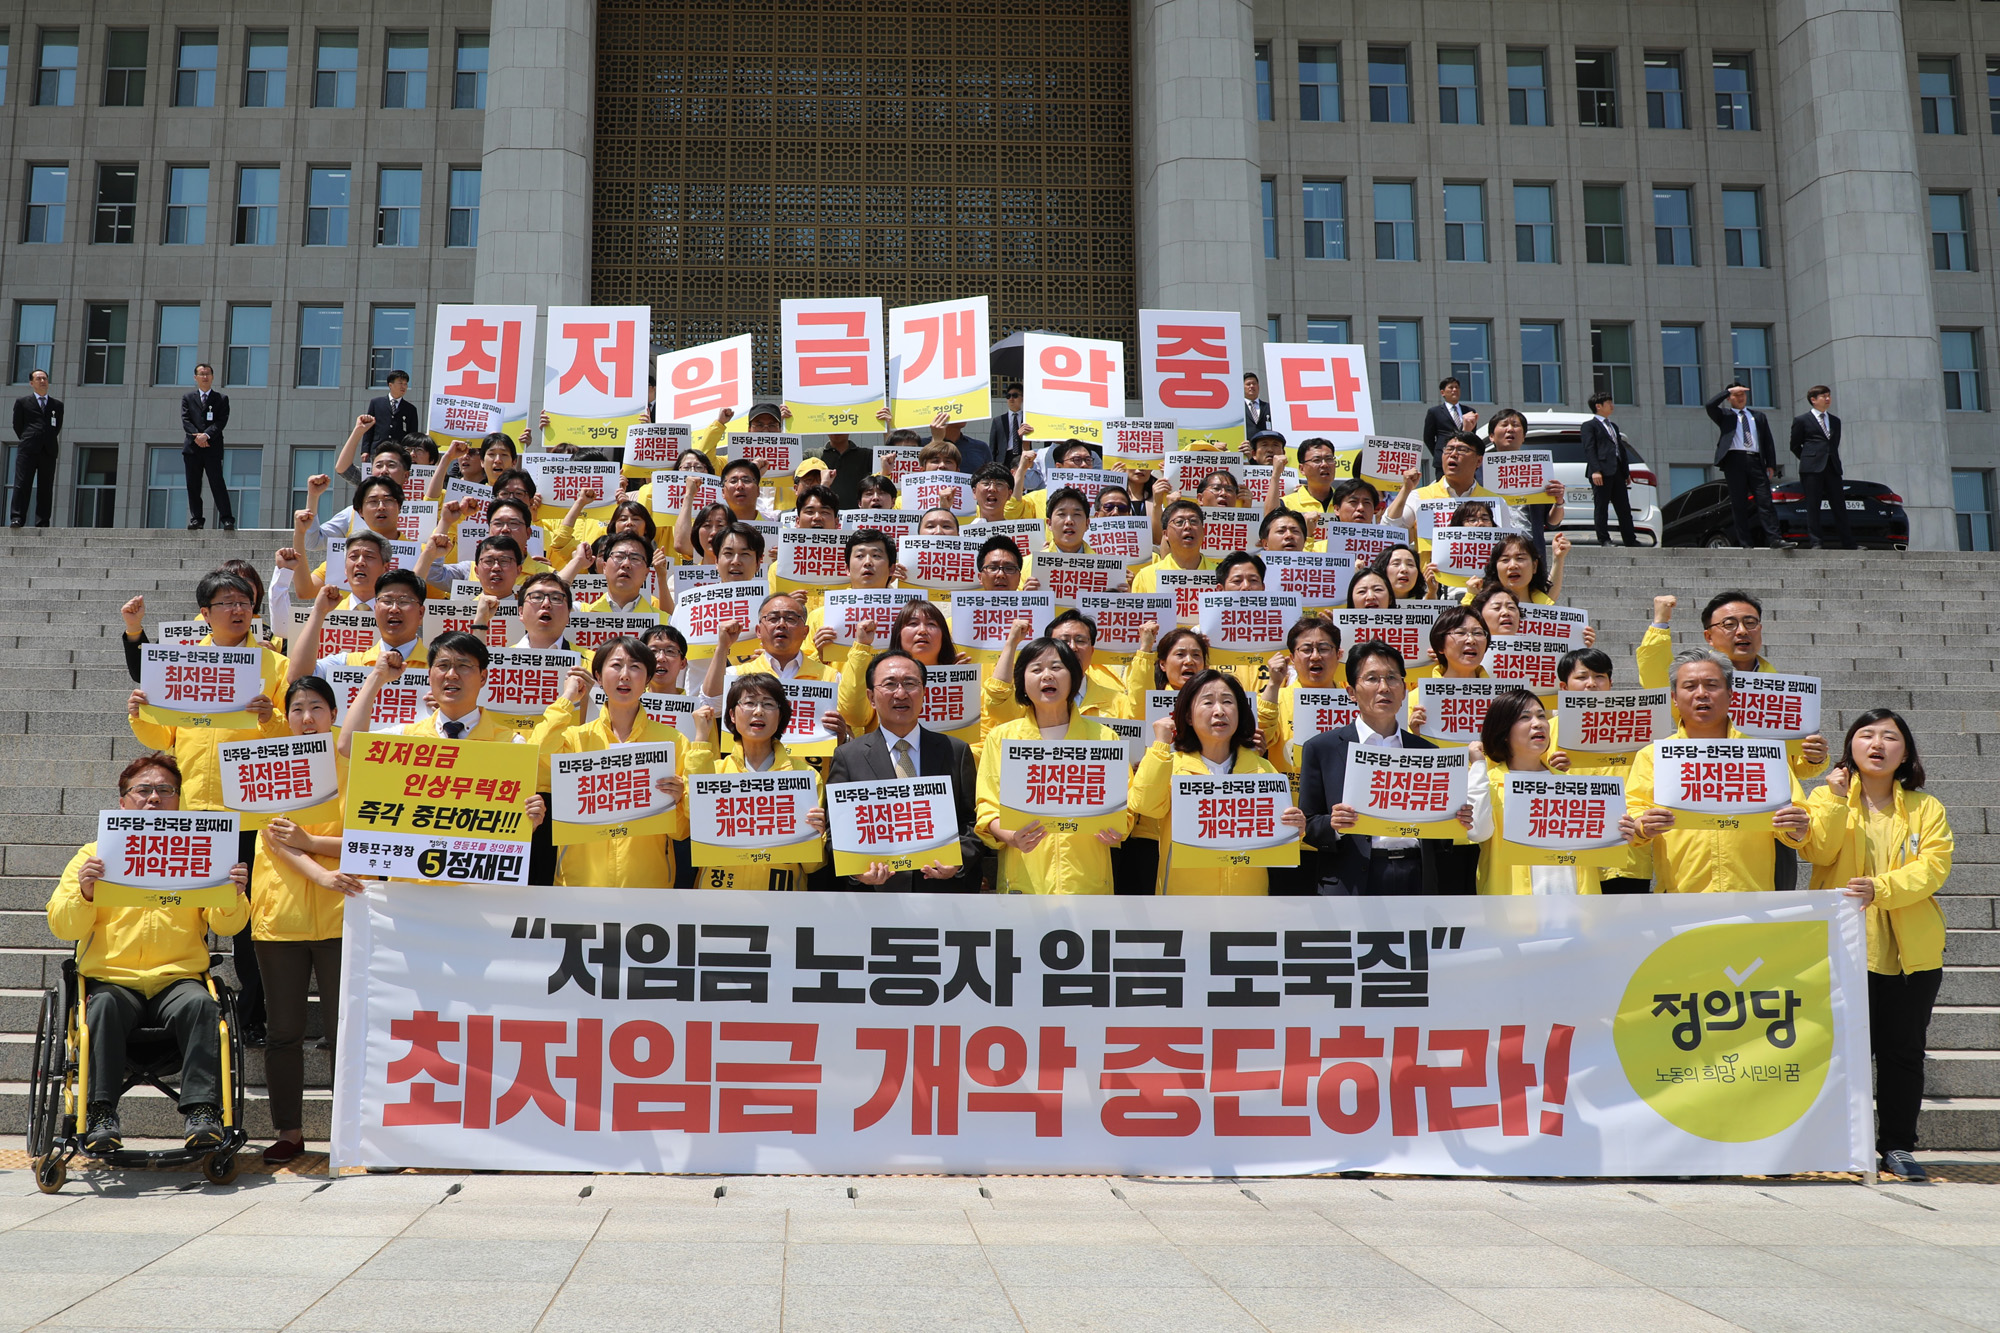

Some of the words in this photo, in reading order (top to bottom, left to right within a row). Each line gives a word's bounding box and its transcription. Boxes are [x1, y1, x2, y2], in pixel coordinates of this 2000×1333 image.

[796, 312, 870, 386] 금
[904, 310, 976, 383] 개
[444, 319, 521, 403] 최
[560, 321, 635, 397] 저
[1156, 325, 1230, 409] 중
[672, 349, 738, 420] 임
[1040, 346, 1115, 408] 악
[1281, 358, 1360, 432] 단
[446, 408, 488, 420] 최저임금
[829, 414, 858, 426] 정의당
[444, 420, 487, 432] 개악규탄
[588, 428, 618, 439] 정의당
[1070, 426, 1098, 437] 정의당
[635, 438, 677, 449] 최저임금
[1118, 431, 1163, 442] 최저임금
[1369, 440, 1405, 449] 민주당-한국당
[634, 450, 678, 461] 개악규탄
[743, 447, 789, 458] 최저임금
[1118, 442, 1164, 453] 개악규탄
[1378, 450, 1416, 464] 최저임금
[1499, 464, 1542, 477] 최저임금
[554, 476, 603, 488] 최저임금
[1499, 477, 1543, 488] 개악규탄
[783, 534, 837, 544] 민주당-한국당
[964, 525, 1015, 538] 민주당-한국당
[905, 540, 960, 550] 민주당-한국당
[918, 552, 974, 567] 최저임금
[1038, 557, 1095, 568] 민주당-한국당
[1266, 556, 1322, 566] 민주당-한국당
[917, 565, 975, 582] 개악규탄
[1050, 569, 1107, 587] 최저임금
[1282, 568, 1334, 582] 최저임금
[682, 588, 733, 606] 민주당-한국당
[957, 596, 1018, 606] 민주당-한국당
[1082, 598, 1144, 608] 민주당-한국당
[1205, 596, 1267, 607] 민주당-한국당
[691, 600, 749, 621] 최저임금
[1222, 610, 1282, 625] 최저임금
[1340, 614, 1403, 625] 민주당-한국당
[1222, 627, 1283, 641] 개악규탄
[148, 650, 219, 664] 민주당-한국당
[223, 653, 254, 664] 짬짜미
[1493, 654, 1556, 671] 최저임금
[166, 666, 234, 684] 최저임금
[487, 668, 559, 688] 최저임금
[165, 685, 235, 702] 개악규탄
[488, 686, 559, 705] 개악규탄
[1788, 681, 1816, 694] 짬짜미
[1565, 696, 1636, 708] 민주당-한국당
[1638, 694, 1666, 706] 짬짜미
[1731, 691, 1802, 713] 최저임금
[1582, 709, 1652, 728] 최저임금
[1730, 708, 1802, 730] 개악규탄
[1581, 727, 1653, 744] 개악규탄
[223, 744, 289, 762] 민주당-한국당
[292, 740, 327, 755] 짬짜미
[365, 741, 459, 769] 최저임금
[1009, 747, 1087, 760] 민주당-한국당
[1090, 748, 1123, 760] 짬짜미
[1355, 751, 1434, 768] 민주당-한국당
[1437, 754, 1464, 768] 짬짜미
[1662, 745, 1744, 758] 민주당-한국당
[1747, 746, 1781, 759] 짬짜미
[559, 754, 632, 773] 민주당-한국당
[635, 750, 667, 765] 짬짜미
[238, 759, 310, 783] 최저임금
[1027, 764, 1105, 784] 최저임금
[1681, 762, 1765, 782] 최저임금
[404, 774, 520, 803] 인상무력화
[578, 768, 650, 795] 최저임금
[697, 779, 775, 794] 민주당-한국당
[778, 778, 810, 791] 짬짜미
[1180, 781, 1255, 795] 민주당-한국당
[1258, 777, 1287, 791] 짬짜미
[1371, 770, 1450, 791] 최저임금
[1513, 781, 1588, 795] 민주당-한국당
[1591, 783, 1620, 795] 짬짜미
[240, 779, 312, 802] 개악규탄
[835, 785, 910, 803] 민주당-한국당
[913, 782, 946, 796] 짬짜미
[1026, 785, 1106, 805] 개악규탄
[1681, 783, 1768, 802] 개악규탄
[578, 788, 651, 814] 개악규탄
[716, 795, 795, 817] 최저임금
[1199, 798, 1274, 818] 최저임금
[1369, 790, 1449, 811] 개악규탄
[1530, 798, 1606, 818] 최저임금
[358, 801, 405, 826] 즉각
[412, 805, 522, 833] 중단하라!!!
[856, 800, 931, 824] 최저임금
[108, 817, 192, 831] 민주당-한국당
[196, 819, 232, 832] 짬짜미
[717, 815, 796, 837] 개악규탄
[858, 820, 934, 844] 개악규탄
[1199, 818, 1275, 838] 개악규탄
[1529, 819, 1605, 838] 개악규탄
[125, 835, 211, 856] 최저임금
[348, 842, 414, 857] 영등포구청장
[430, 840, 447, 848] 정의당
[124, 857, 212, 877] 개악규탄
[425, 852, 440, 875] 5
[447, 852, 523, 882] 정재민
[792, 927, 1021, 1006] 노동자
[1040, 930, 1185, 1008] 임금
[1651, 990, 1801, 1051] 정의당
[383, 1011, 822, 1134] 최저임금
[854, 1025, 1076, 1137] 개악
[1100, 1024, 1575, 1136] 중단하라!
[1656, 1067, 1697, 1083] 노동의
[1702, 1062, 1735, 1083] 희망
[1741, 1065, 1781, 1081] 시민의
[1785, 1064, 1800, 1082] 꿈
